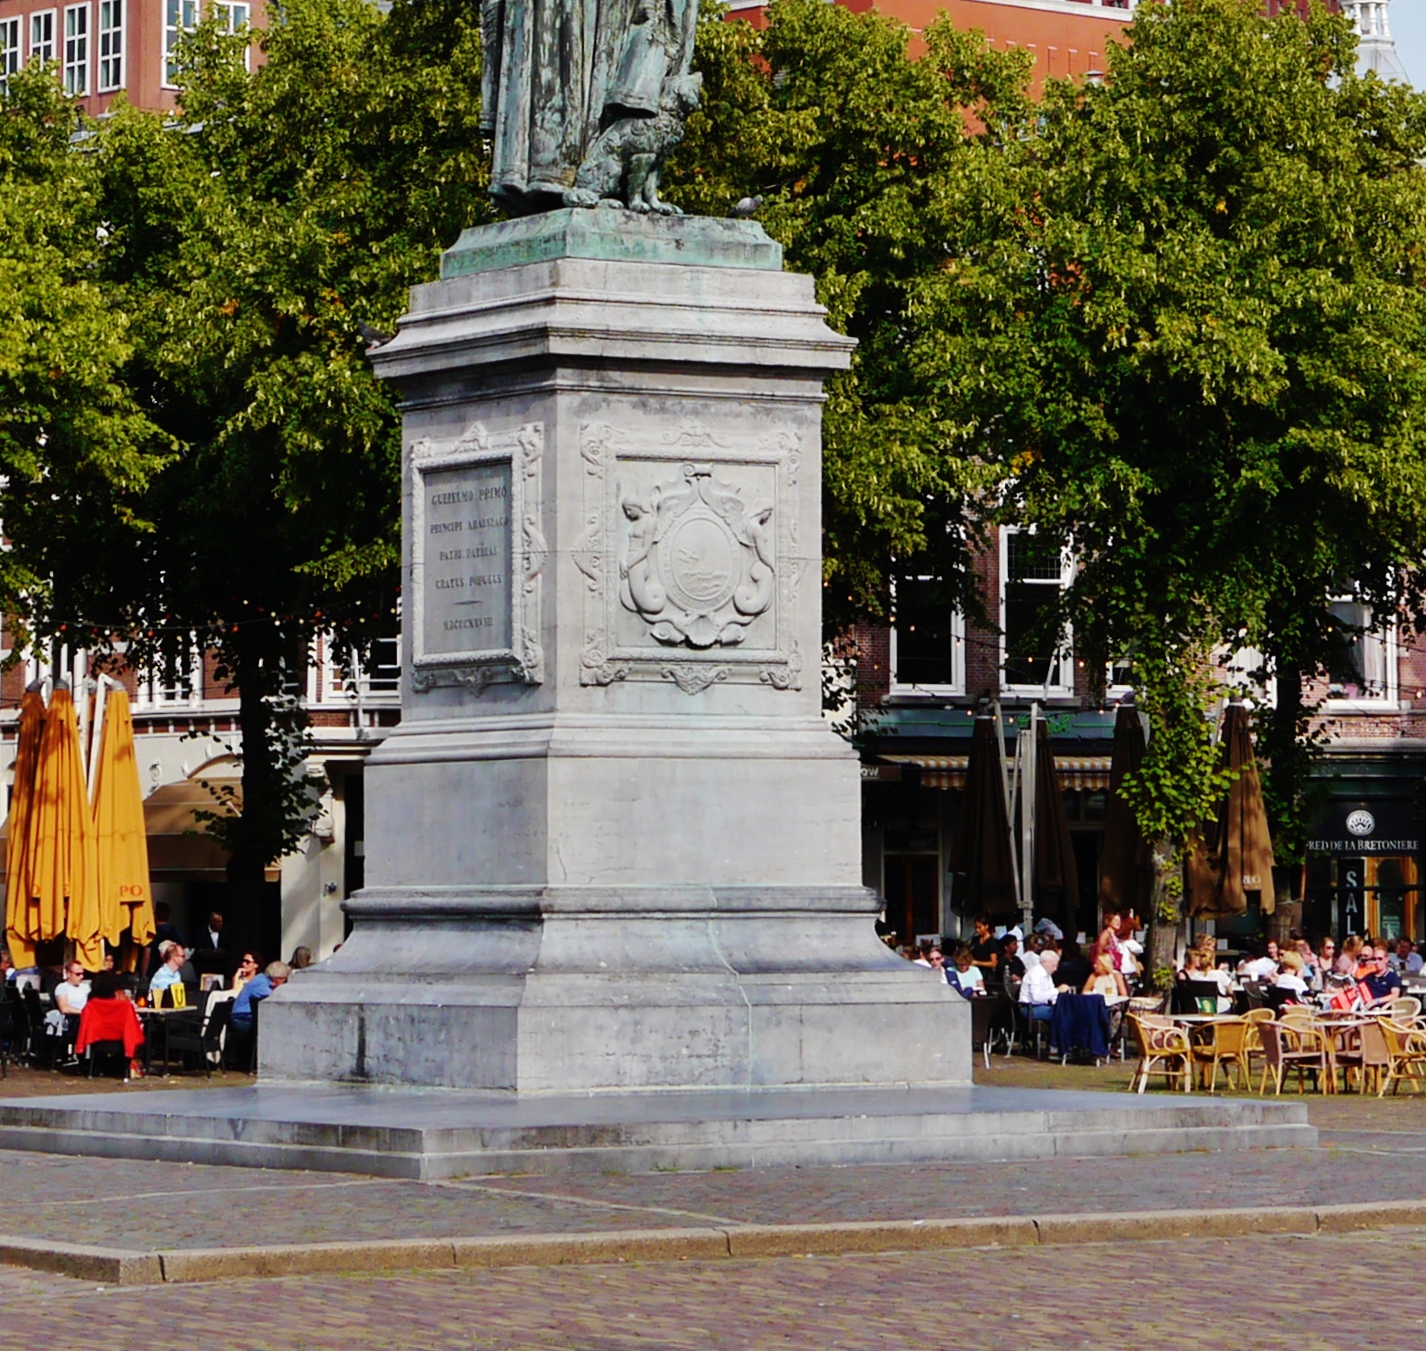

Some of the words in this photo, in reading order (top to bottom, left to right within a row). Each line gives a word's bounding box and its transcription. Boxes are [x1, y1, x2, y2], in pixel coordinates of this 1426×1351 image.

[1306, 840, 1329, 850] RED
[1330, 840, 1344, 850] DE
[1345, 840, 1356, 850] LA
[1357, 839, 1419, 851] BRETONIERE
[1345, 870, 1358, 940] SAL
